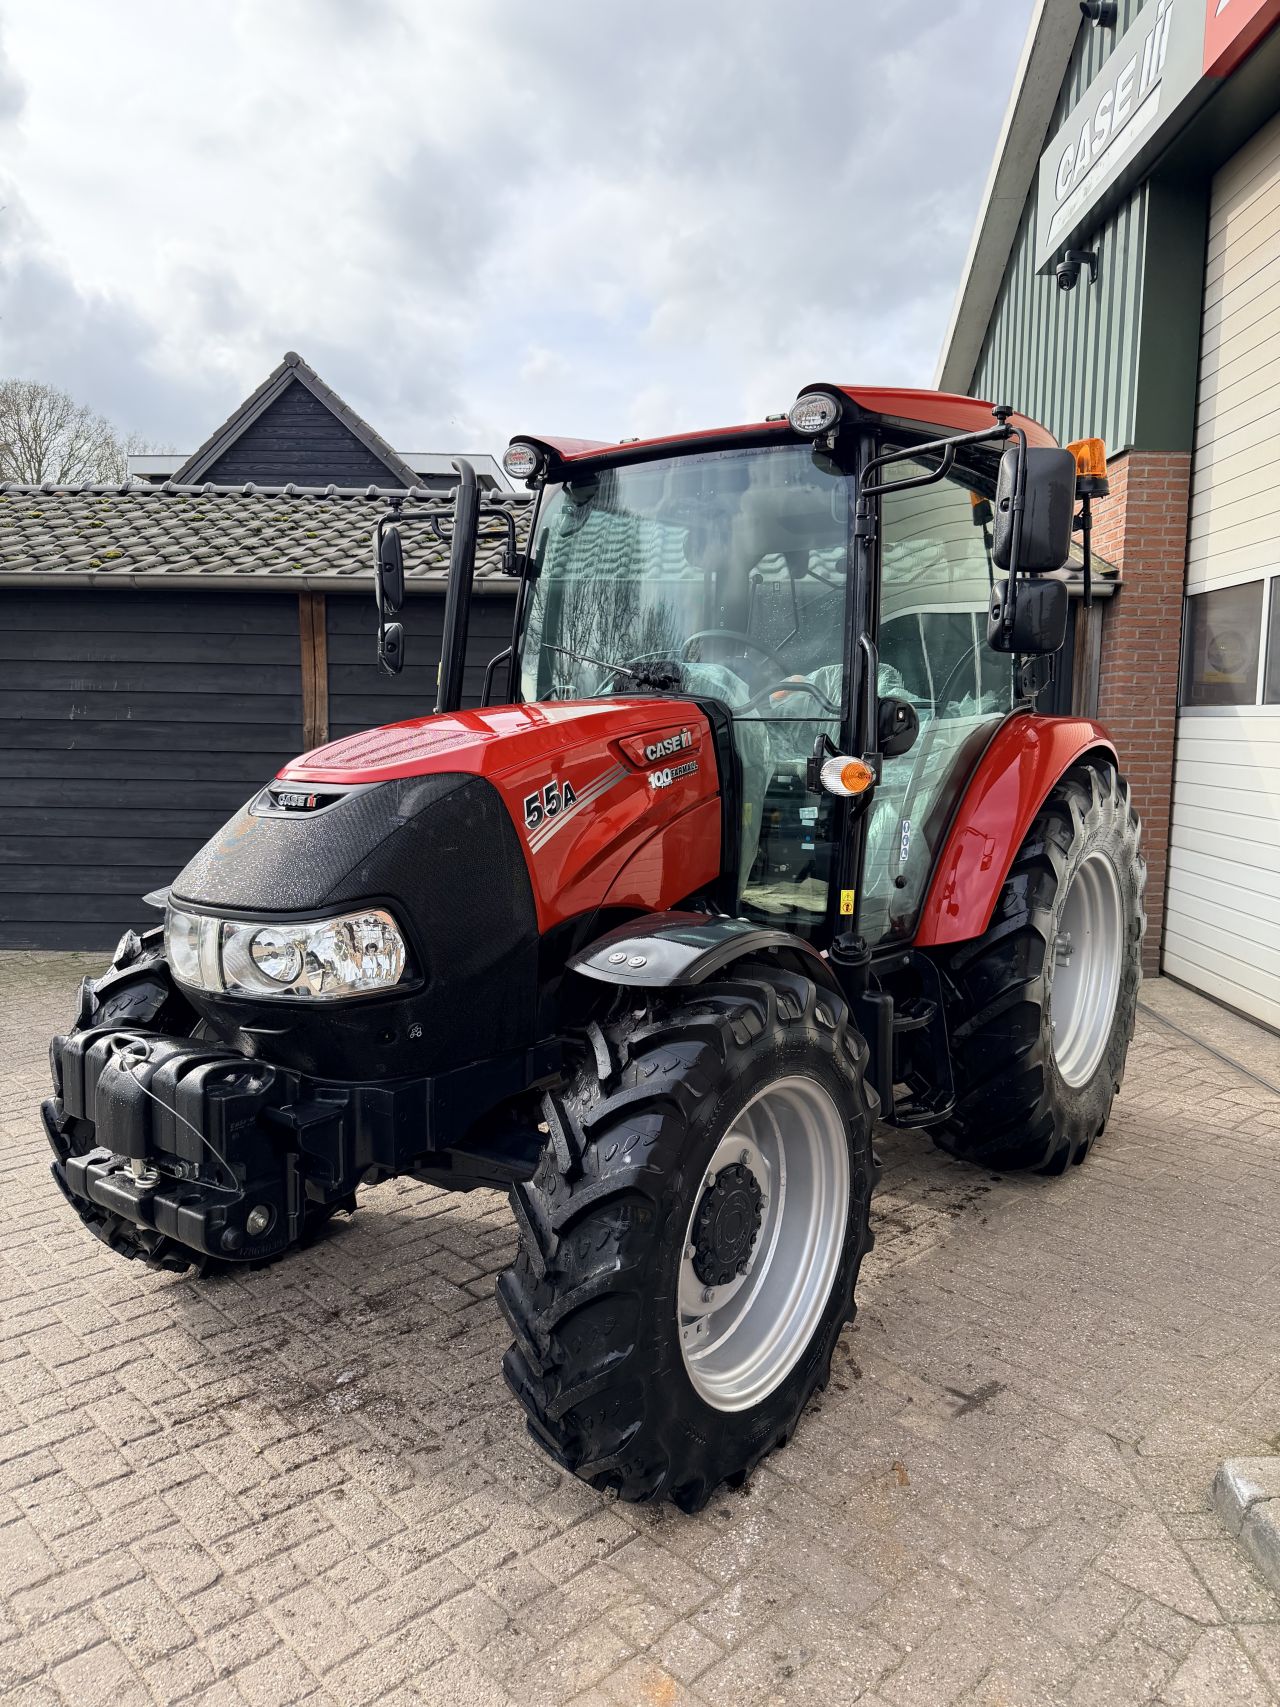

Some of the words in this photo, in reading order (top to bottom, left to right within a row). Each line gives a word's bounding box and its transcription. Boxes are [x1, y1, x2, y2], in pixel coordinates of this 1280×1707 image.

[1055, 51, 1138, 201] CASE
[646, 735, 681, 760] CASE
[278, 793, 306, 807] CASE
[523, 779, 578, 830] 55A
